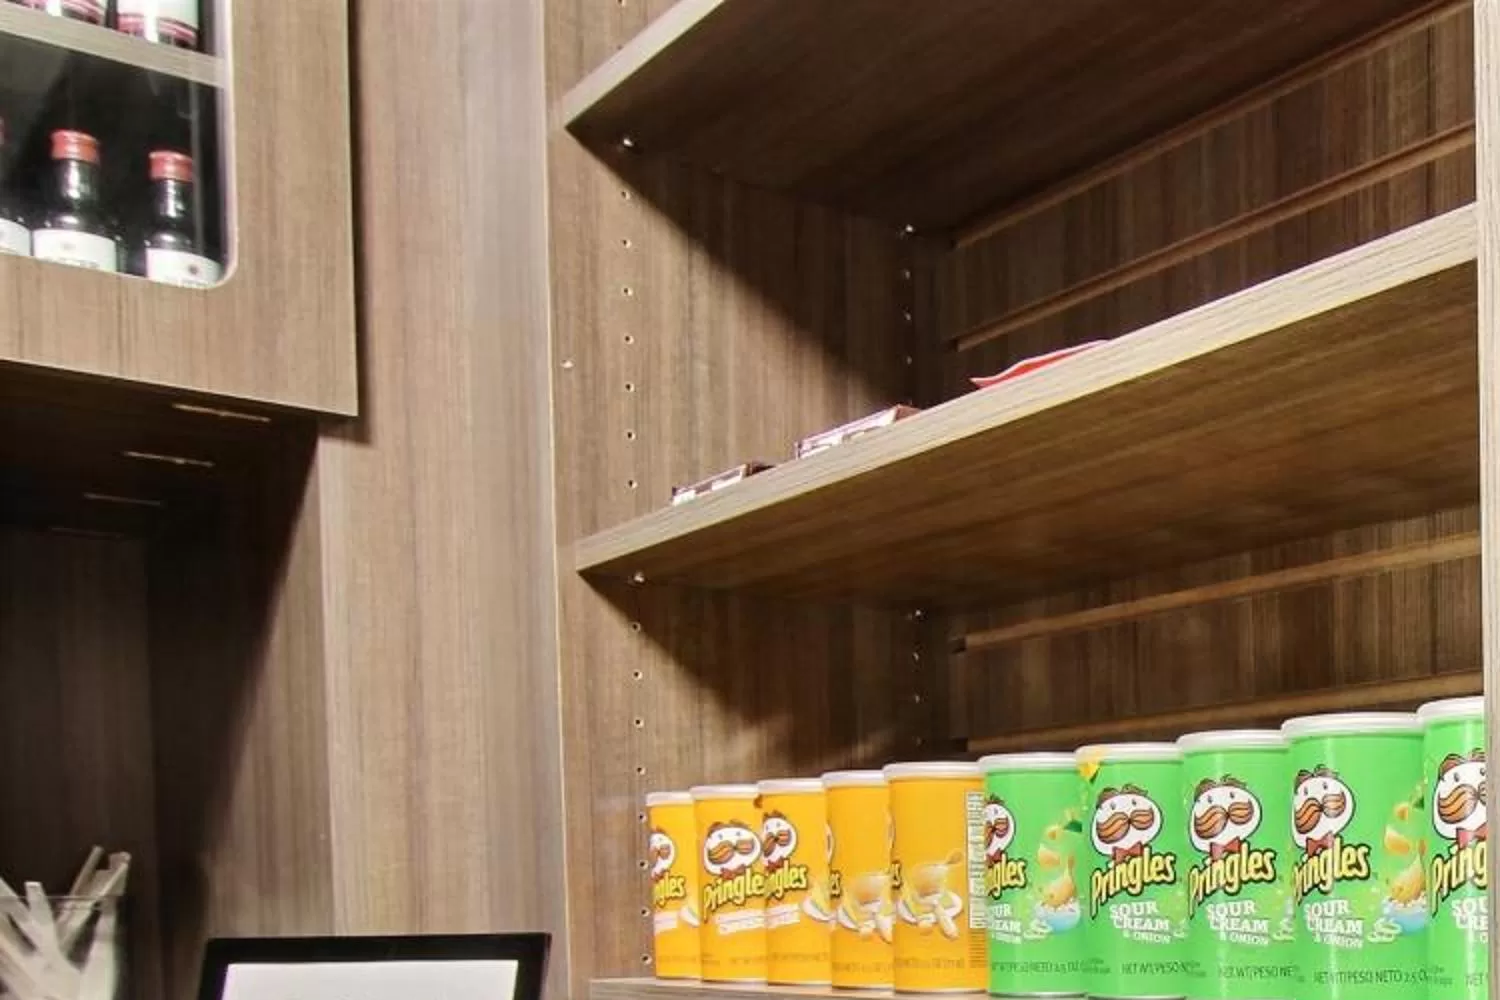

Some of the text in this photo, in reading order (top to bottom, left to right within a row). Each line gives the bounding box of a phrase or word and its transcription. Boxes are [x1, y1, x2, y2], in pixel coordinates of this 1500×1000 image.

[986, 853, 1028, 900] gles
[1091, 845, 1176, 920] Pringles
[1188, 841, 1276, 919] Pringles
[1432, 844, 1488, 917] Pring
[655, 872, 686, 908] gles
[703, 868, 767, 923] Pringle
[1109, 901, 1159, 918] SOUR
[1207, 900, 1256, 918] SOUR
[1304, 900, 1350, 918] SOUR
[1113, 915, 1170, 932] CREAM
[1210, 915, 1269, 933] CREAM
[1306, 916, 1364, 934] CREAM
[1455, 915, 1488, 930] CRE
